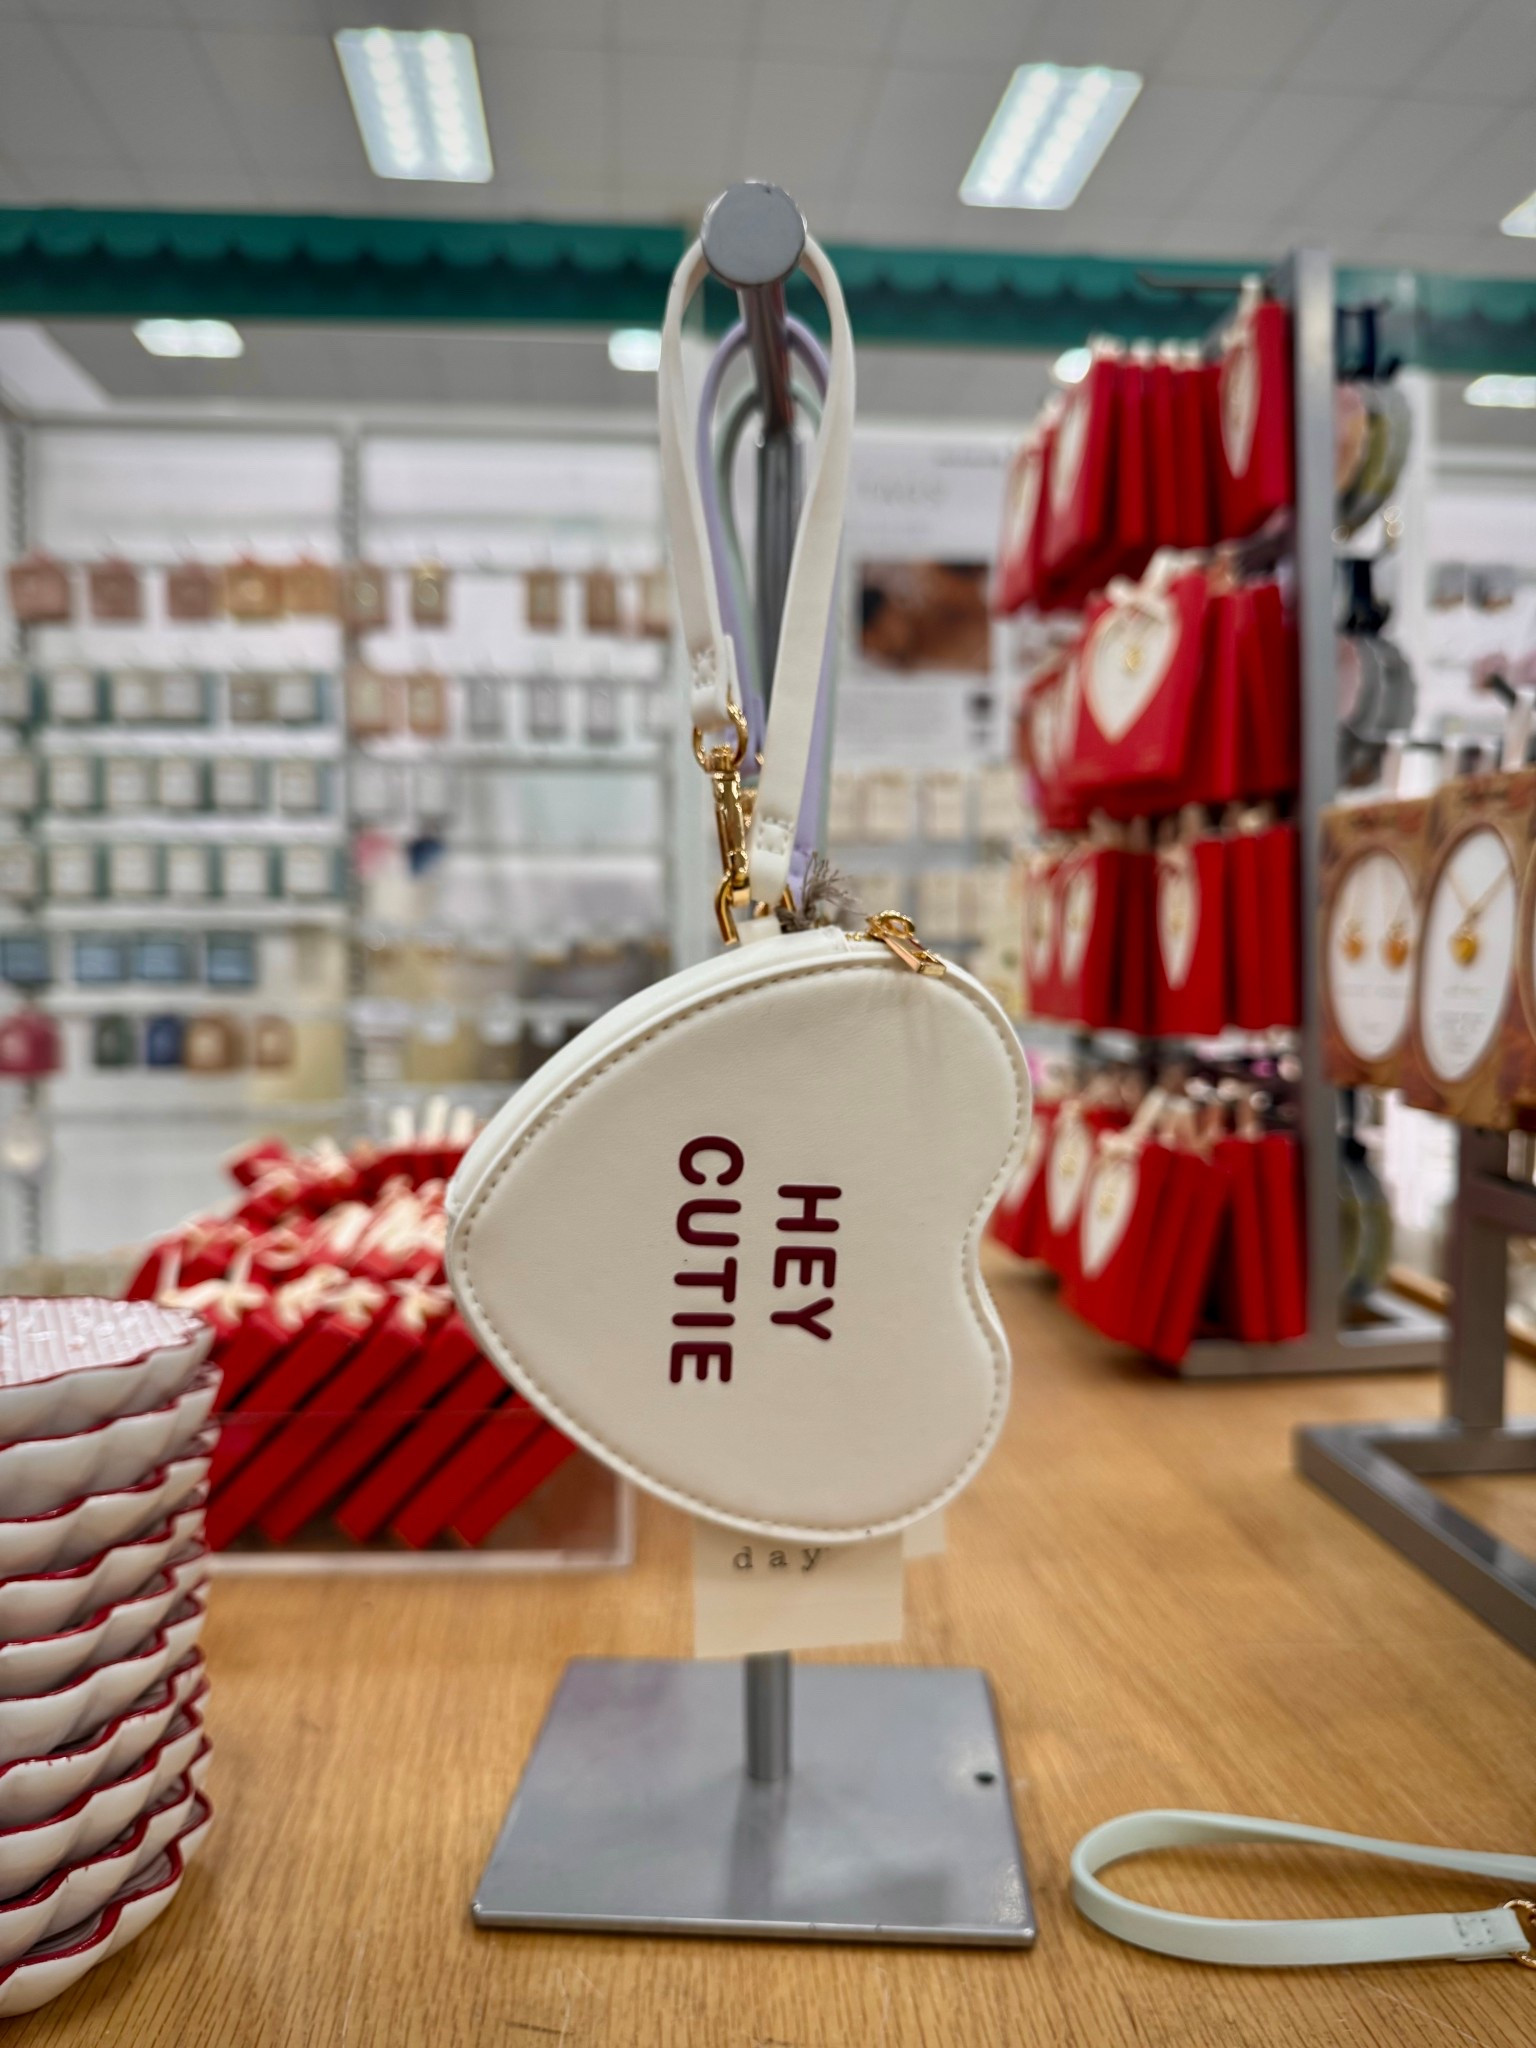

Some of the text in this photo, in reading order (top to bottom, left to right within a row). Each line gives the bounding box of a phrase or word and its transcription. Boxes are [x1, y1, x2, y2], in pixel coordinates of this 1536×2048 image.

[669, 1135, 744, 1384] CUTIE
[769, 1184, 842, 1341] HEY
[732, 1545, 824, 1572] day
